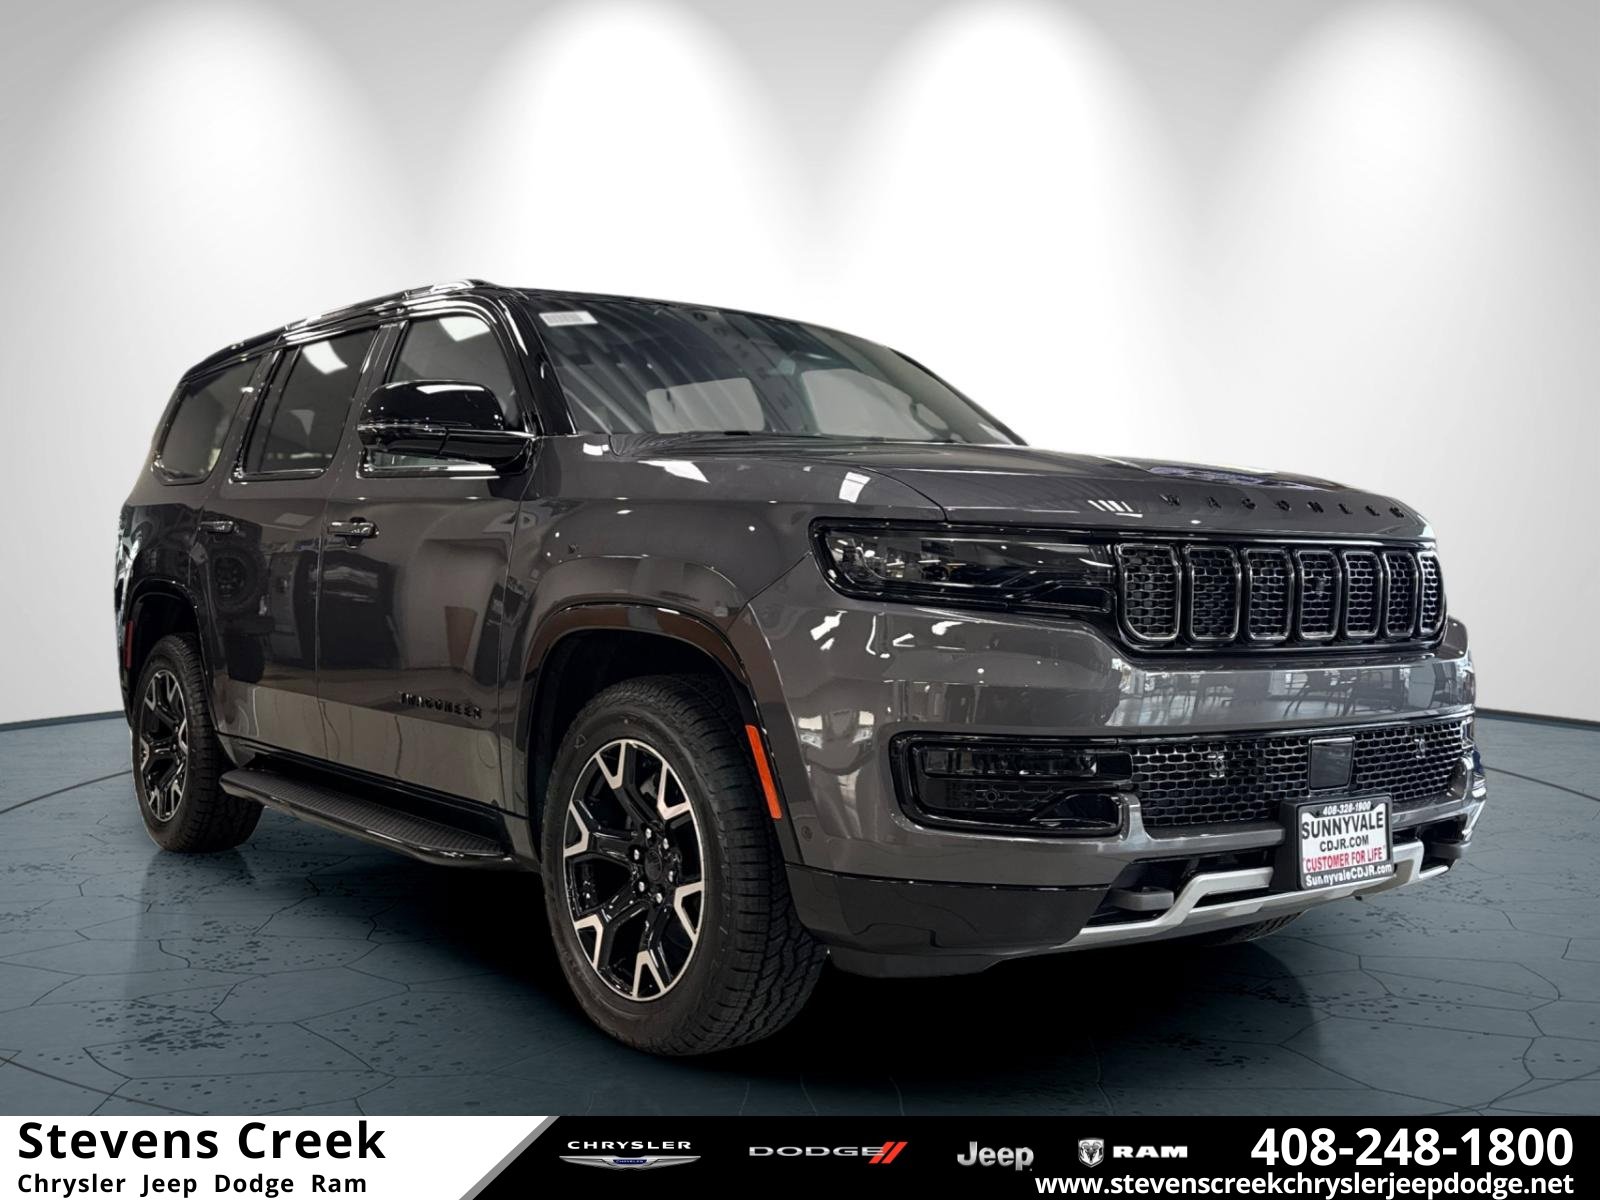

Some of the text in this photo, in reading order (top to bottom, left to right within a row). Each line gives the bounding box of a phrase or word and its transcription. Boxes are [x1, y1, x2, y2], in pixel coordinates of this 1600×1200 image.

[1160, 492, 1406, 519] WAGONEER
[1302, 811, 1384, 840] SUNNYVALE
[1319, 834, 1369, 852] CDJR.COM
[1305, 846, 1382, 872] CUSTOMER FOR LIFE
[1305, 863, 1392, 887] SunnyvaleCDJR.com
